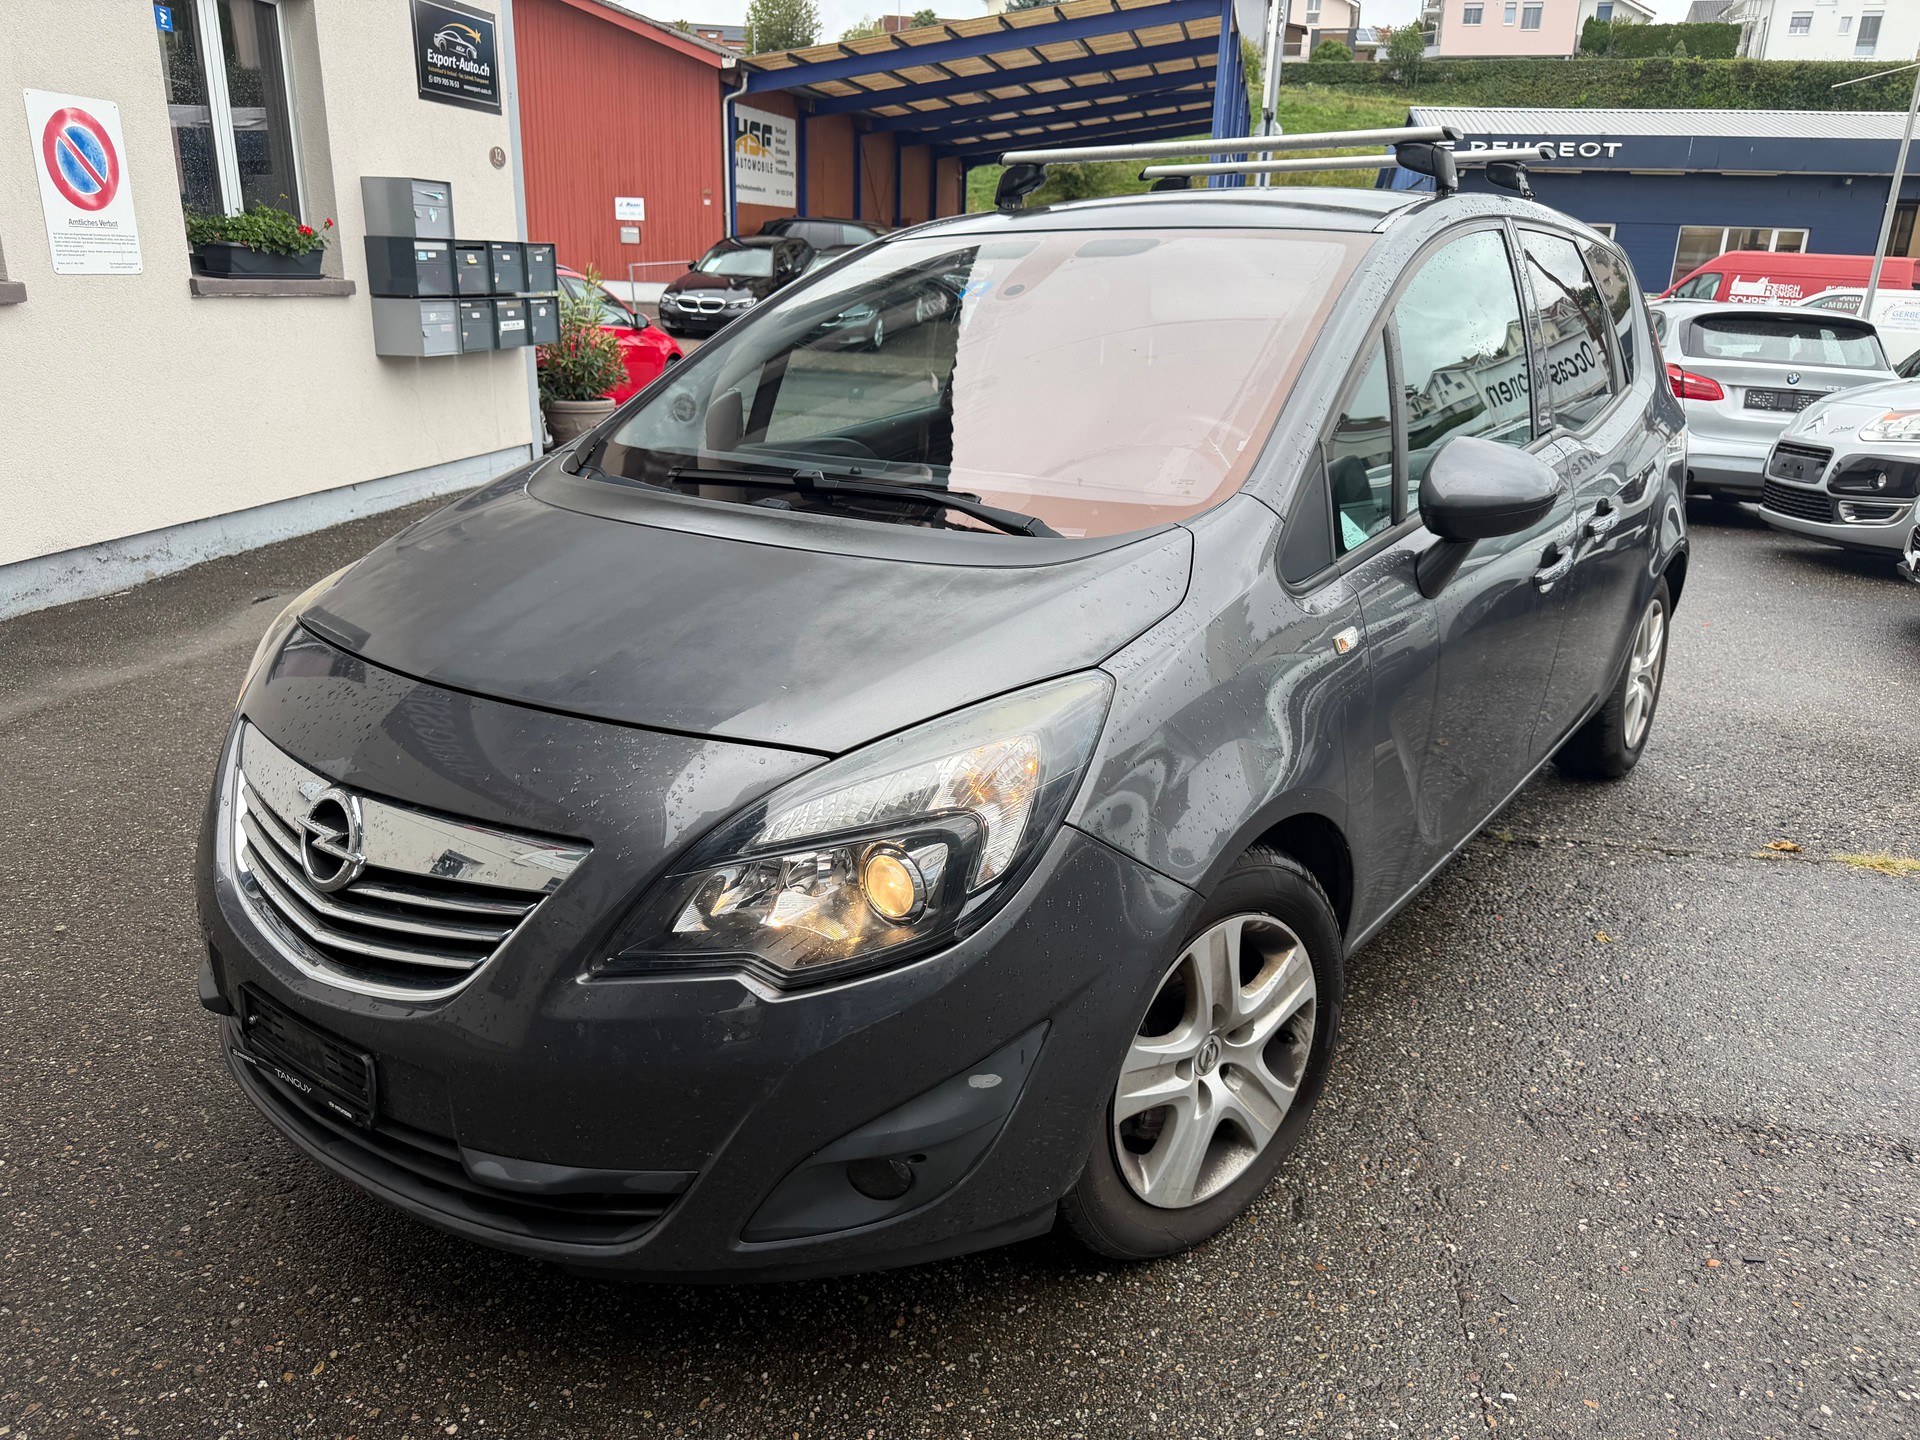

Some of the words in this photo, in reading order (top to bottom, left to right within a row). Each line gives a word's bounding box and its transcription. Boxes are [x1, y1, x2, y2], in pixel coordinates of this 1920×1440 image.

[427, 48, 490, 77] Export-Auto.ch
[736, 157, 773, 174] AUTOMOBILE
[68, 218, 99, 227] Amtliches
[98, 219, 119, 228] Verbot
[274, 1067, 313, 1094] TANGUY
